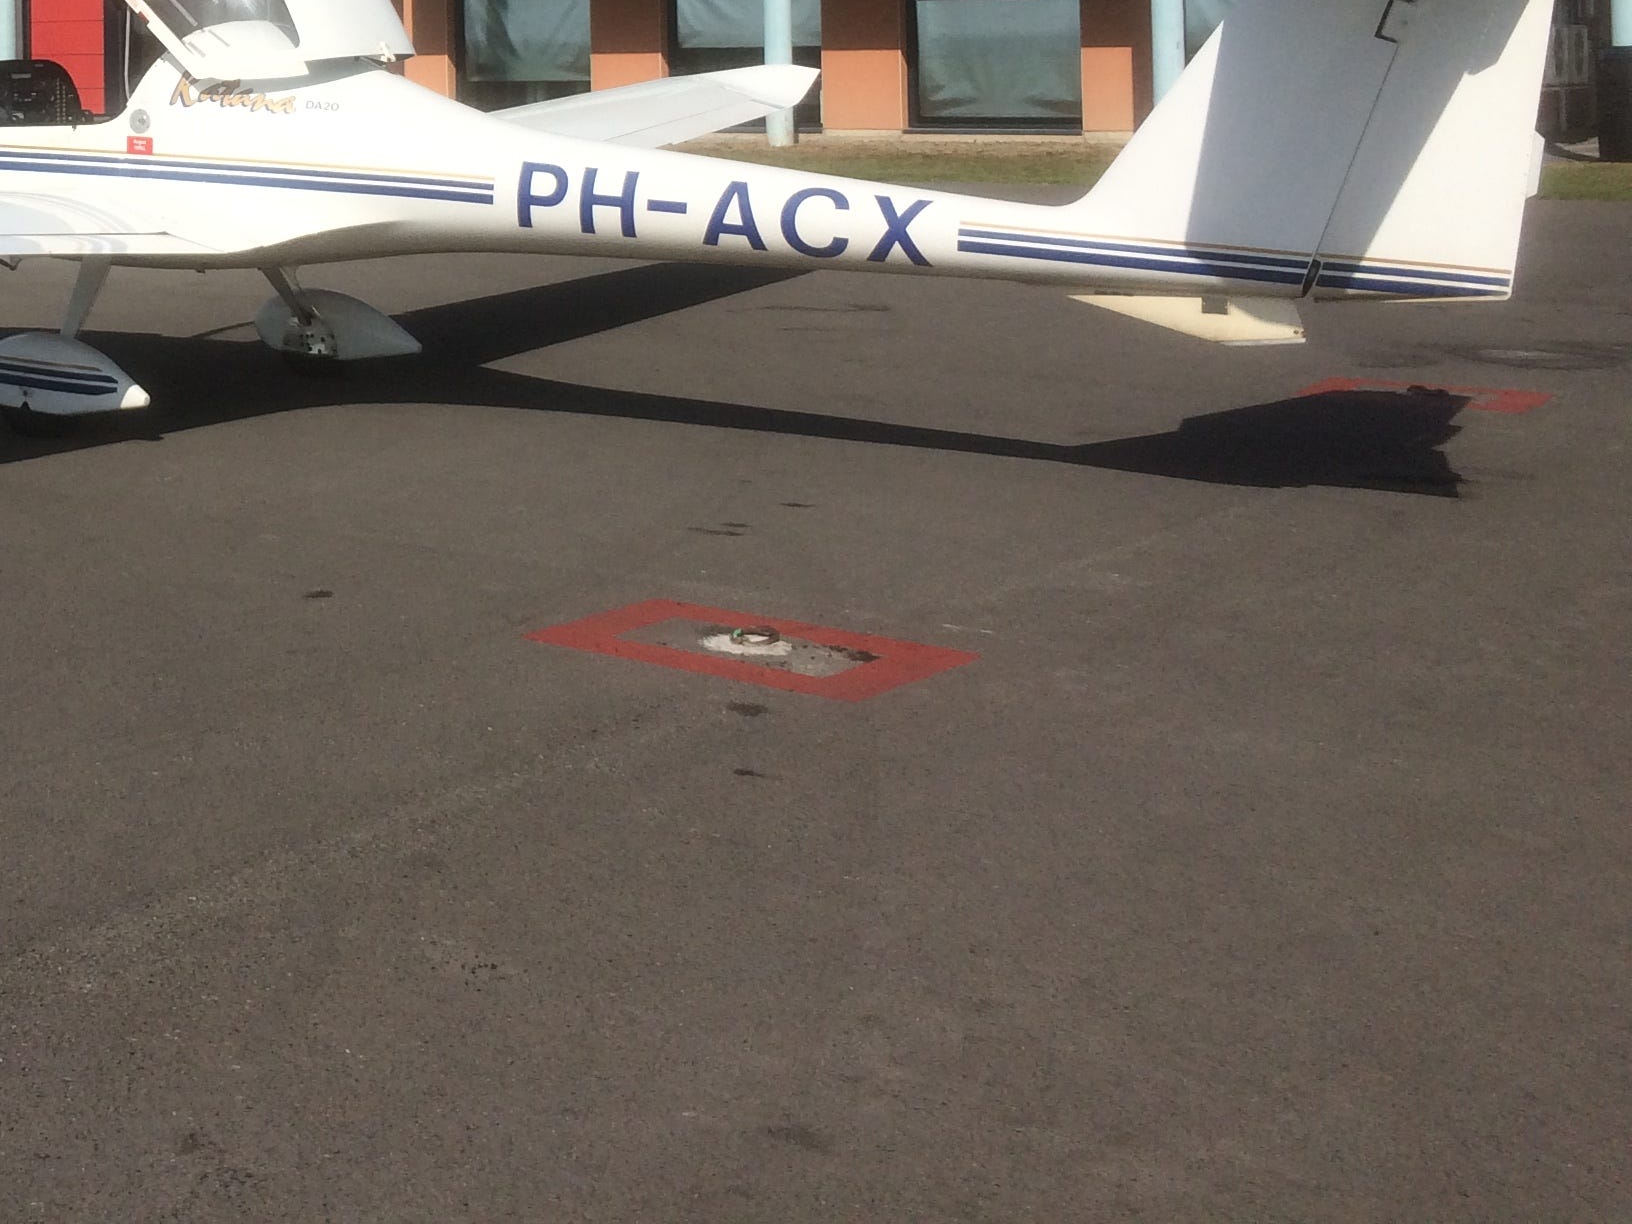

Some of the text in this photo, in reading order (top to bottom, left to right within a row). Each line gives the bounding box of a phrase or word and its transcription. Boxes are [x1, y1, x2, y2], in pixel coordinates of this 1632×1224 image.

[169, 70, 296, 114] Katana
[305, 99, 340, 112] DA20
[517, 160, 934, 267] PH-ACX
